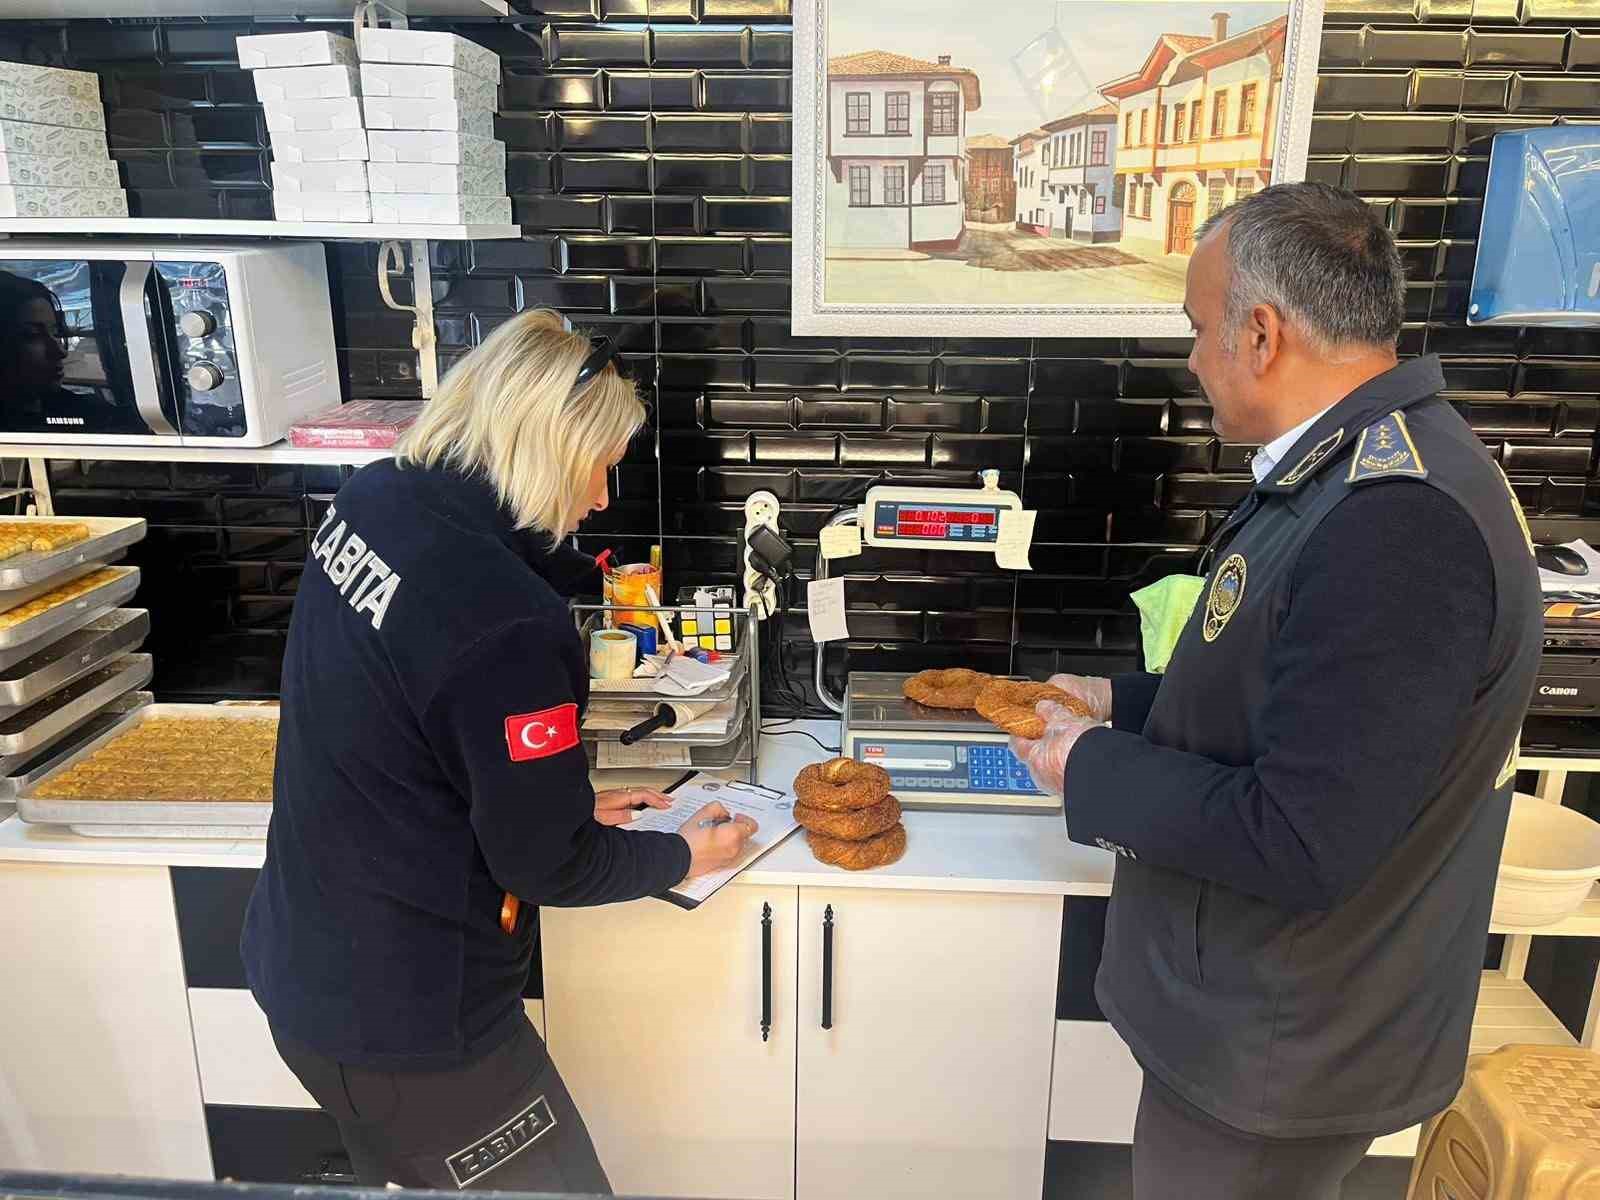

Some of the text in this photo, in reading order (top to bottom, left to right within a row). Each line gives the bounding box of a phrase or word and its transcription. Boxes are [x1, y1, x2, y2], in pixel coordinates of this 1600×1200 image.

[46, 417, 84, 425] SAMSUNG
[311, 503, 401, 631] ZABITA
[1539, 686, 1578, 696] Canon
[460, 1112, 542, 1173] ZABITA
